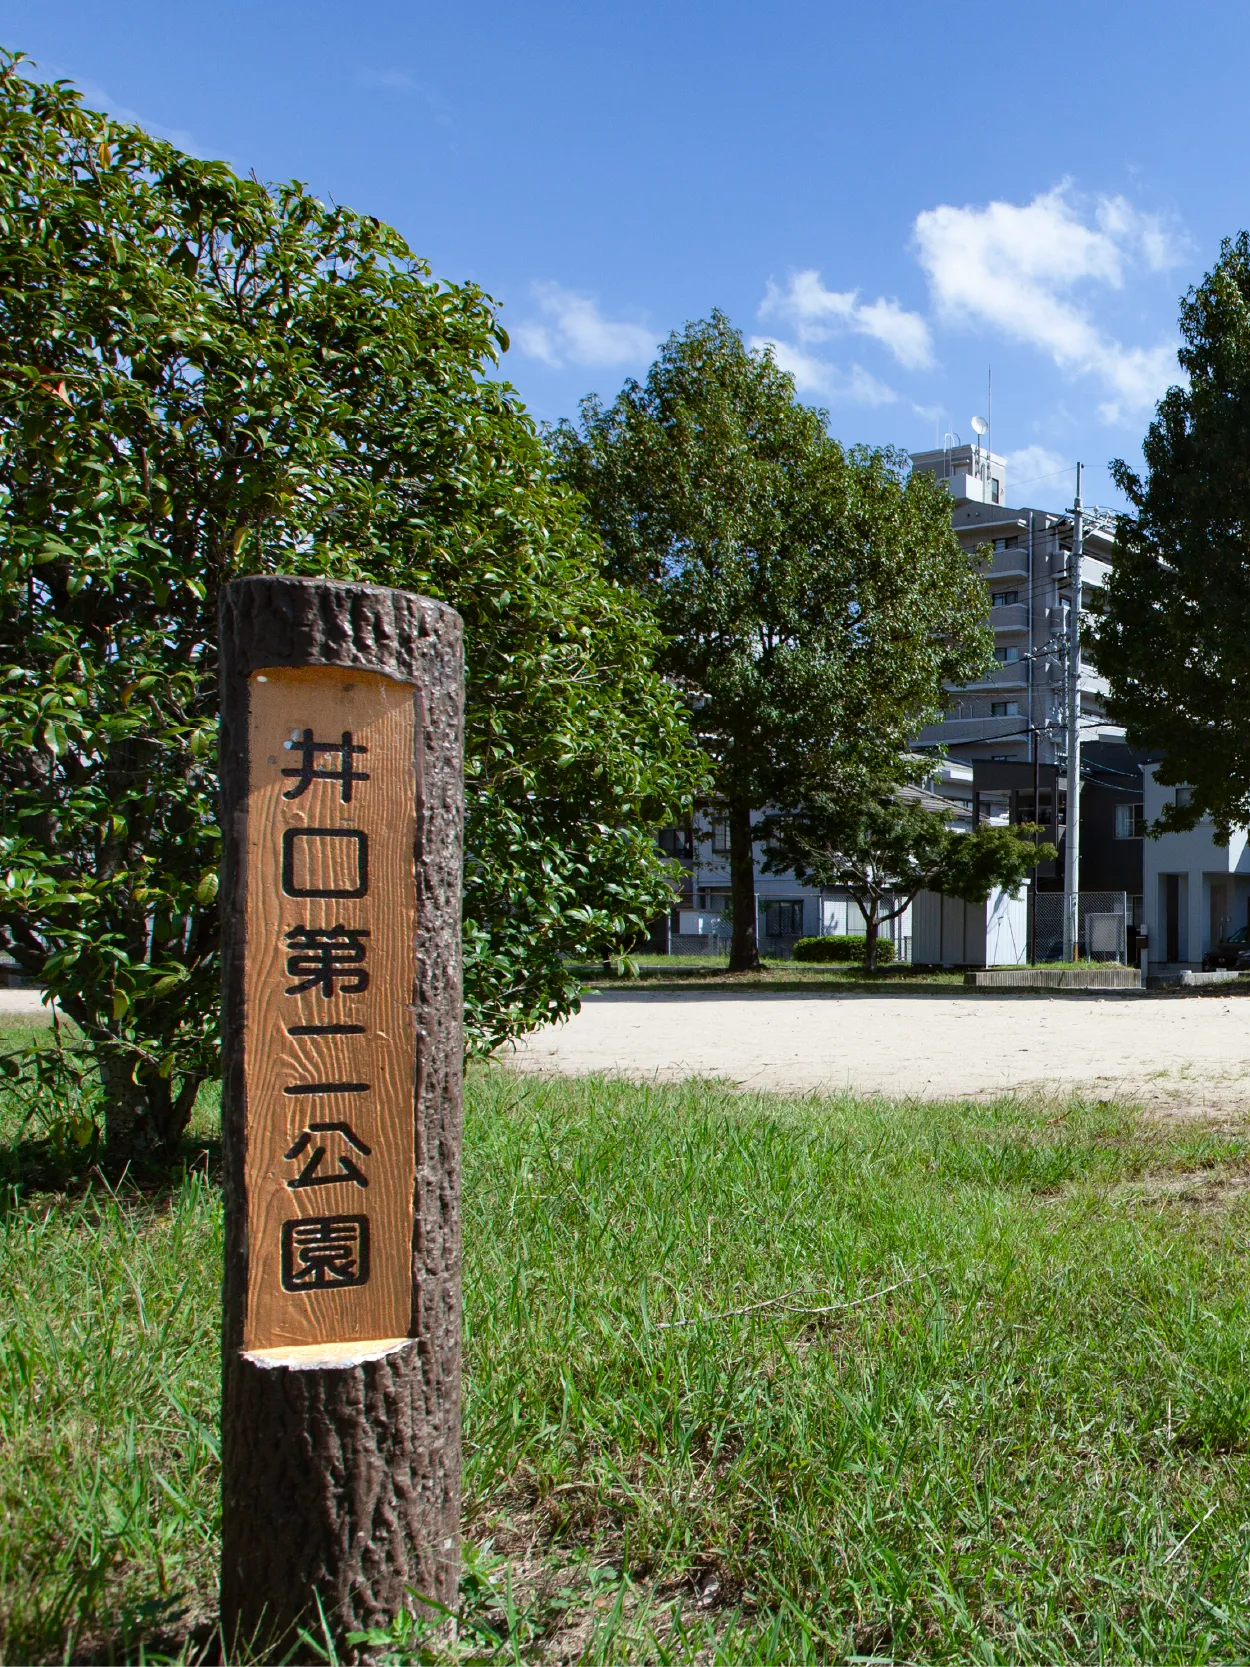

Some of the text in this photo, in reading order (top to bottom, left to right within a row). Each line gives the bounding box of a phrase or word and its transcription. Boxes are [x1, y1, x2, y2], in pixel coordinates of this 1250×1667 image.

[281, 728, 370, 1293] 井口第二公園
